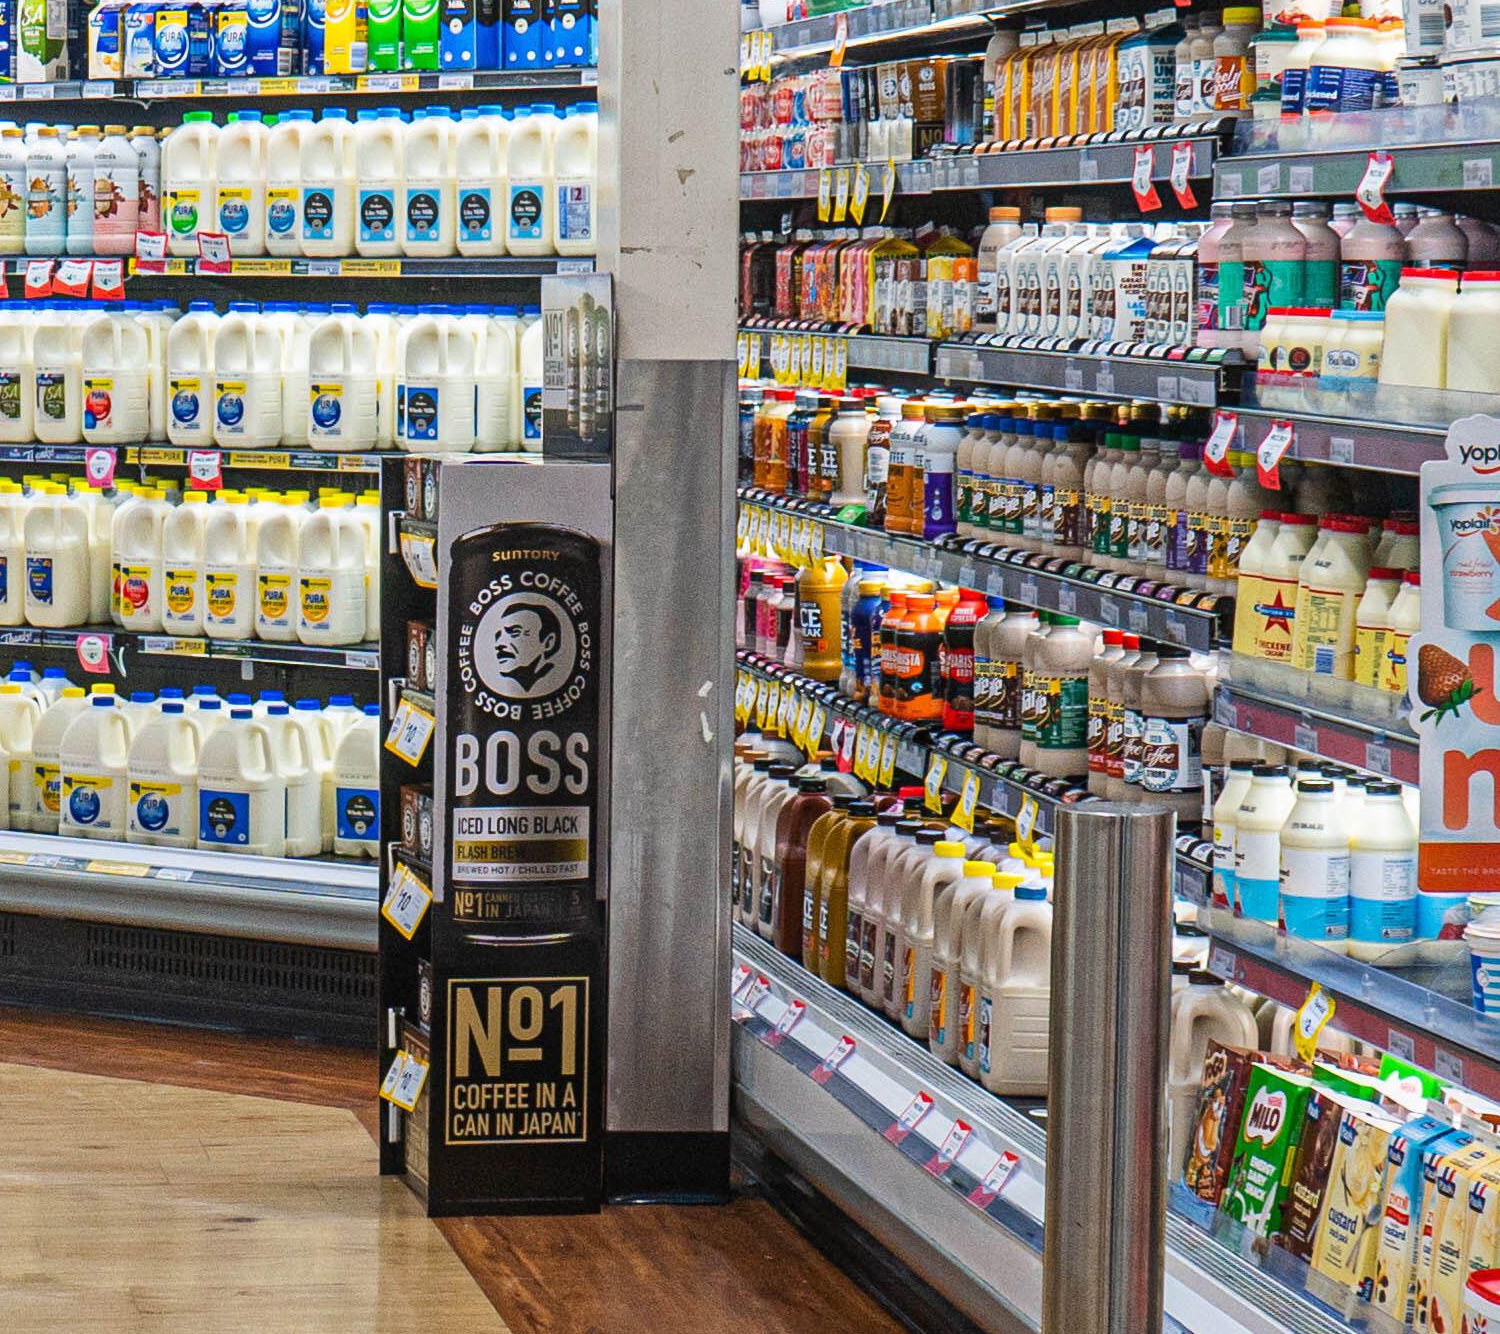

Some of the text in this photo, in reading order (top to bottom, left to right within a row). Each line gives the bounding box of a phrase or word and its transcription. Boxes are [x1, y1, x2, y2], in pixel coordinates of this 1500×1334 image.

[21, 3, 44, 26] SA
[159, 30, 182, 43] PURA
[221, 30, 243, 43] PURA
[173, 205, 193, 215] PURA
[222, 203, 245, 214] PURA
[270, 203, 291, 214] PURA
[1449, 517, 1492, 531] yoplait
[170, 585, 190, 597] PURA
[210, 588, 231, 600] PURA
[263, 590, 284, 601] PURA
[305, 593, 325, 604] PURA
[799, 606, 822, 627] CE
[459, 571, 591, 721] BOSS COFFEE BOSS COFFEE BOSS COFFEE
[1254, 637, 1292, 651] THICKENE
[1142, 740, 1177, 769] Coffee
[455, 730, 590, 797] BOSS
[458, 816, 578, 835] ICED LONG BLACK
[457, 845, 488, 860] FLASH
[491, 865, 511, 874] HOT
[453, 1082, 576, 1109] COFFEE IN A
[453, 1113, 489, 1136] CAN
[496, 1112, 512, 1136] IN
[1248, 1101, 1280, 1133] MILO
[1293, 1181, 1321, 1208] custard
[1328, 1207, 1358, 1235] custard
[1383, 1225, 1406, 1241] custard
